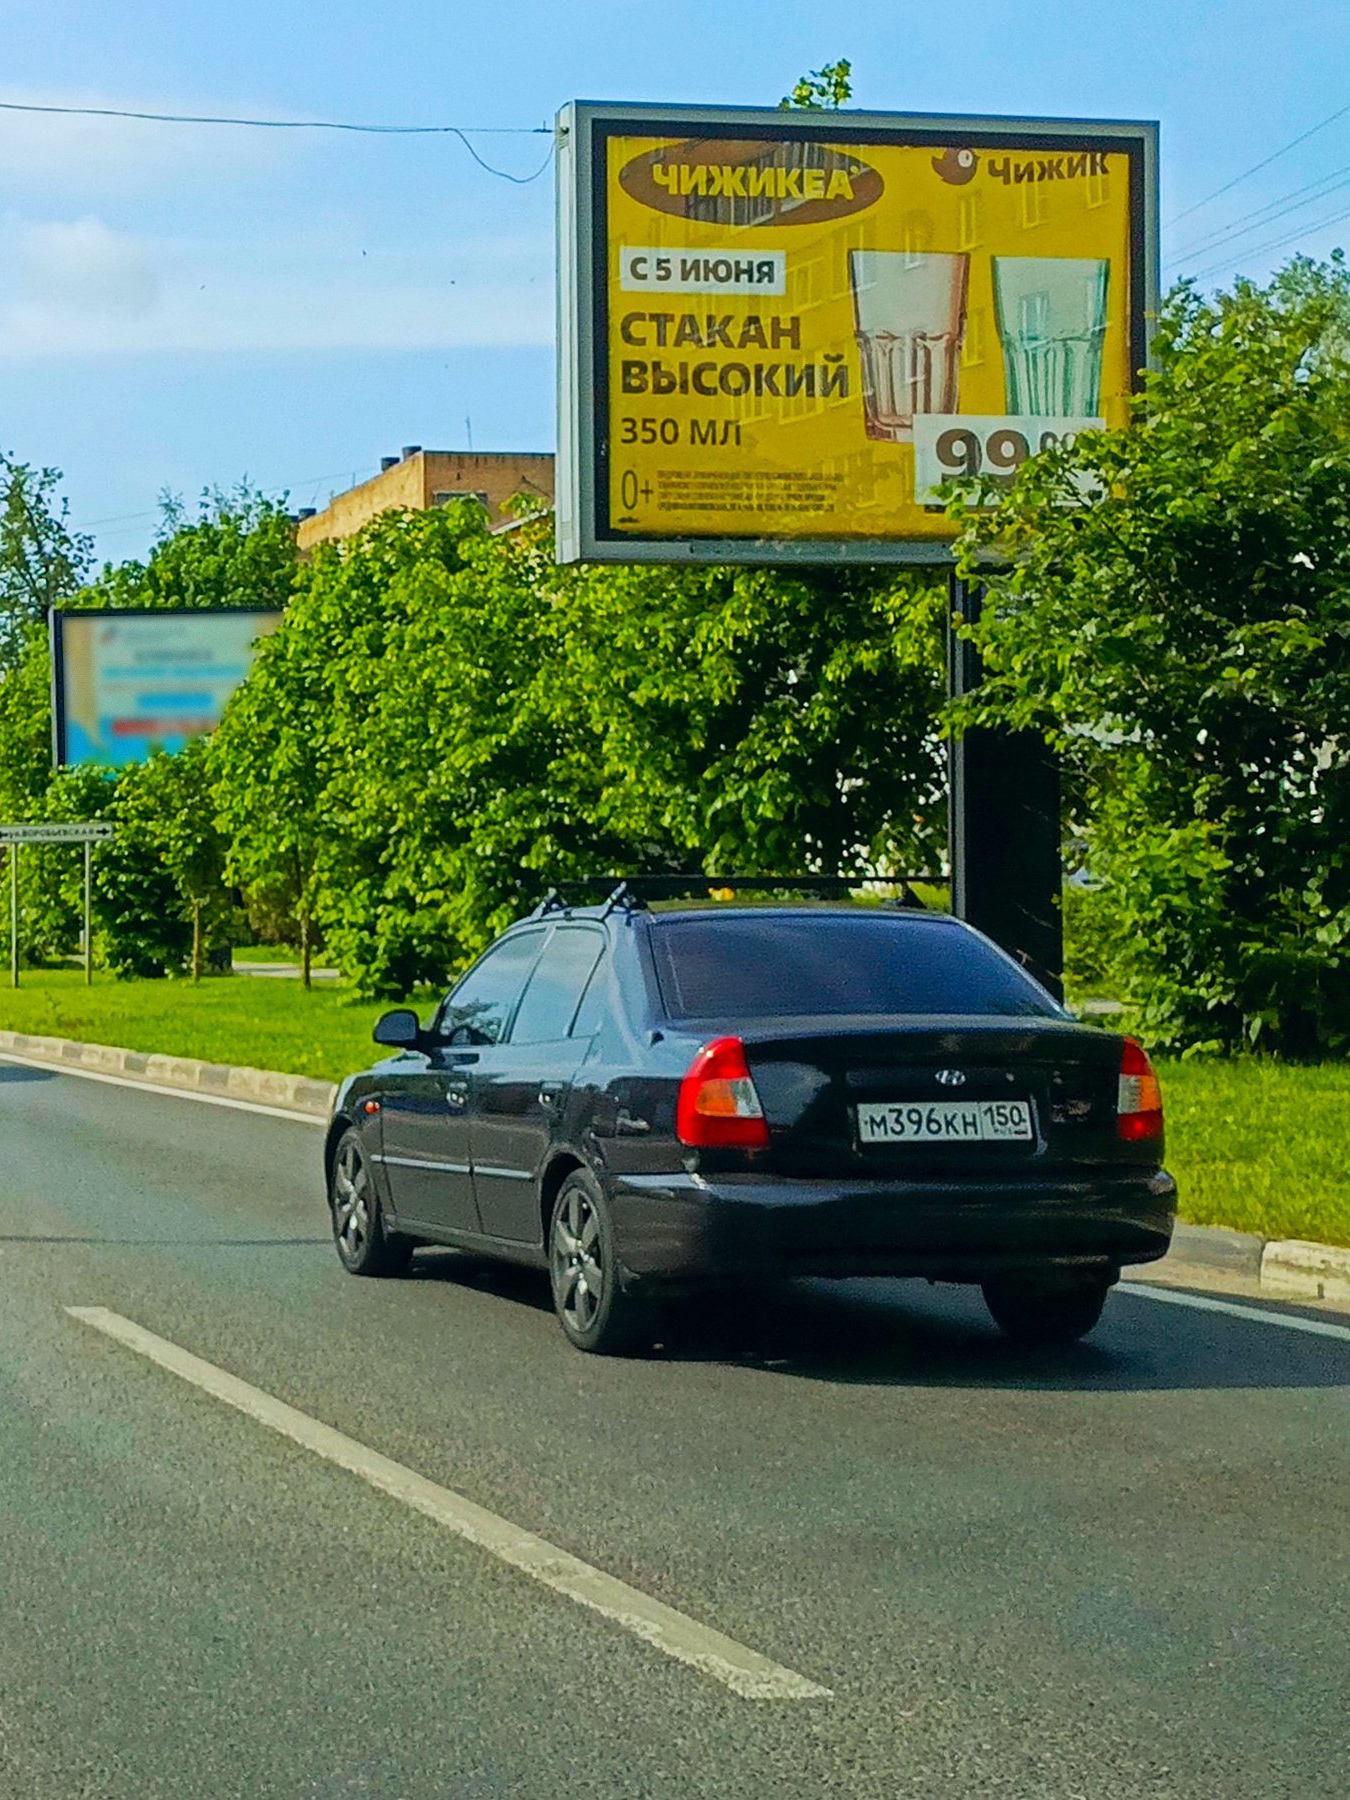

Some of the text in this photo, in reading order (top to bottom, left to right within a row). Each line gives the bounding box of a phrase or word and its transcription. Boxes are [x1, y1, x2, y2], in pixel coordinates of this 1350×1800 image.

[629, 256, 775, 284] С 5 ИЮНЯ
[619, 311, 801, 350] СТАКАН
[621, 353, 849, 398] ВЫСОКИЙ
[621, 417, 742, 446] 350 МЛ
[621, 469, 654, 511] 0+
[869, 1105, 1023, 1137] М396КН 150
